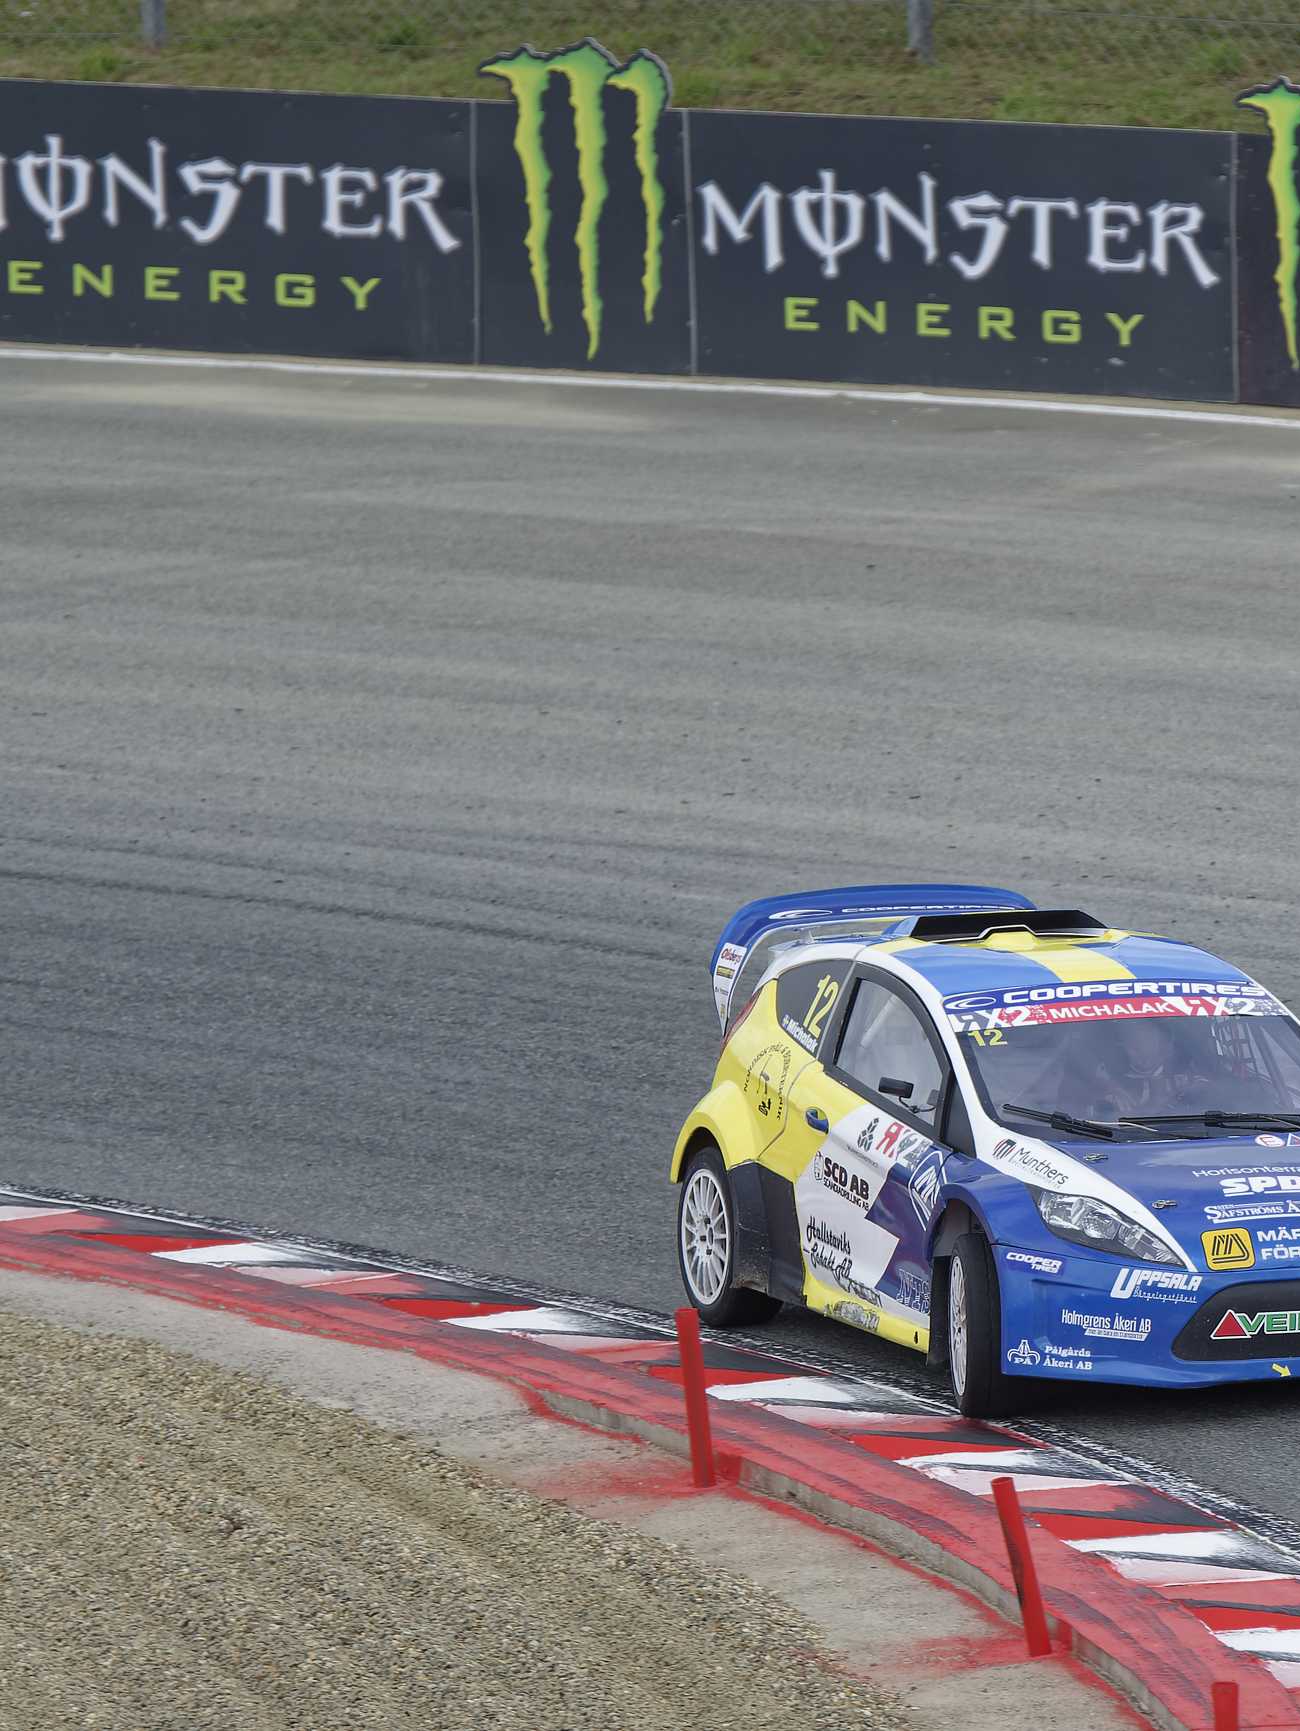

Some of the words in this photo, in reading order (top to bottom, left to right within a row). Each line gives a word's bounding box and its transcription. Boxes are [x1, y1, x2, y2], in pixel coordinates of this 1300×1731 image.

[0, 134, 463, 253] ONSTER
[697, 168, 1220, 289] MONSTER
[7, 259, 382, 310] ENERGY
[784, 296, 1144, 346] ENERGY
[803, 974, 839, 1039] 12
[1003, 982, 1266, 1004] COOPERTIRES
[1050, 1002, 1175, 1019] MICHALAK
[968, 1029, 1008, 1047] 12
[824, 1157, 848, 1187] SCD
[850, 1174, 869, 1200] AB
[1018, 1147, 1069, 1185] Munthers
[1006, 1252, 1063, 1268] COOPER
[1110, 1268, 1203, 1299] UPPSALA
[1061, 1309, 1111, 1329] Holmgrens
[1113, 1312, 1137, 1331] Åkeri
[1139, 1318, 1152, 1333] AB
[1043, 1355, 1073, 1369] Åkeri
[1076, 1361, 1093, 1370] AB
